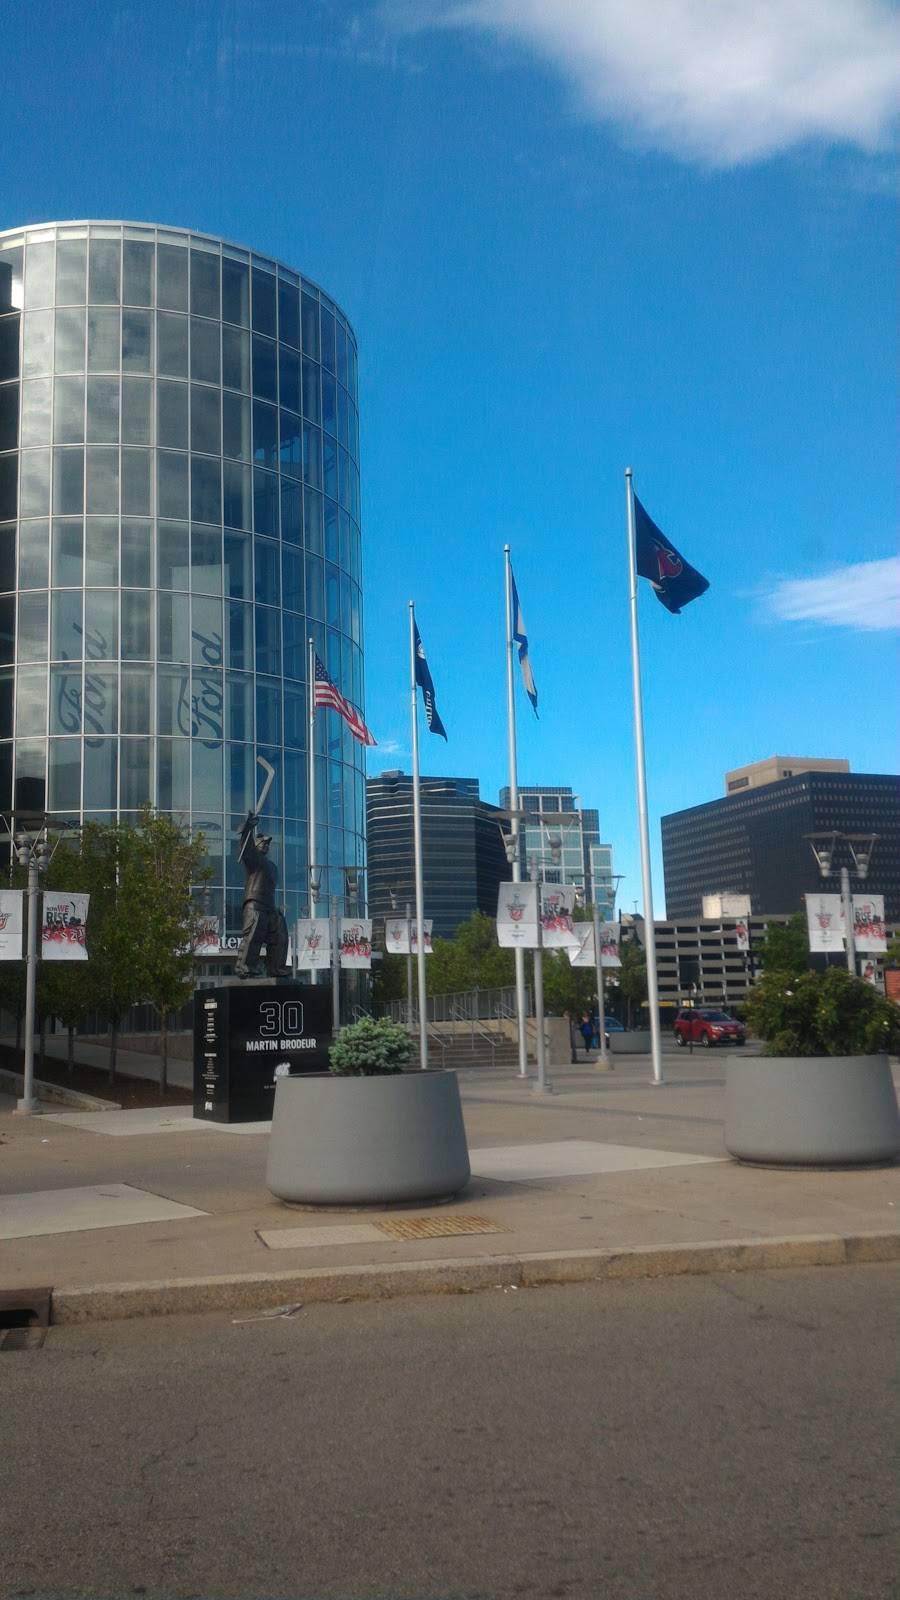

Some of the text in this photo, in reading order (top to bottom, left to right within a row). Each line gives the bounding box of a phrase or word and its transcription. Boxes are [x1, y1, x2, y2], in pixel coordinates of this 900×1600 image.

[58, 622, 107, 748] Ford
[177, 629, 224, 749] Ford
[46, 911, 68, 923] RISE
[343, 933, 359, 942] RISE
[260, 1001, 303, 1036] 30
[246, 1038, 317, 1051] MARTIN BRODEUR
